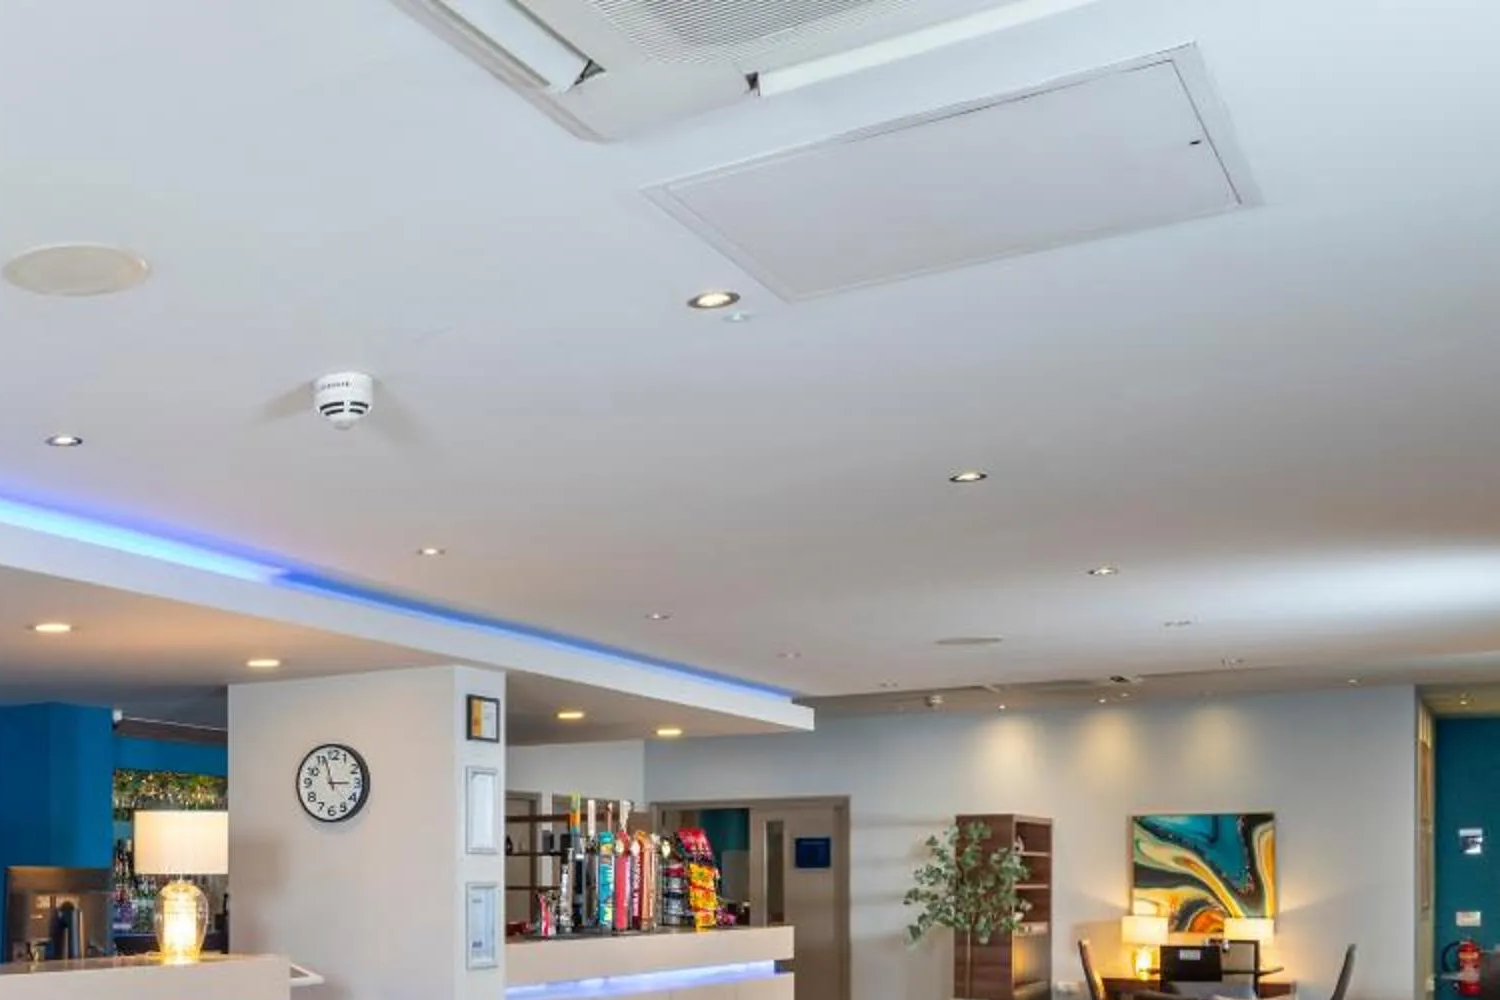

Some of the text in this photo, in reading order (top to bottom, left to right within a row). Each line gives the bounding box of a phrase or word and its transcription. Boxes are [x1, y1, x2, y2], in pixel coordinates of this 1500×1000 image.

[327, 750, 340, 761] 12
[307, 767, 320, 777] 10
[351, 763, 360, 775] 2
[303, 777, 312, 788] 9
[353, 777, 361, 789] 3
[307, 791, 316, 802] 8
[348, 792, 357, 802] 4
[317, 802, 325, 812] 7
[327, 806, 336, 817] 6
[339, 802, 347, 813] 5
